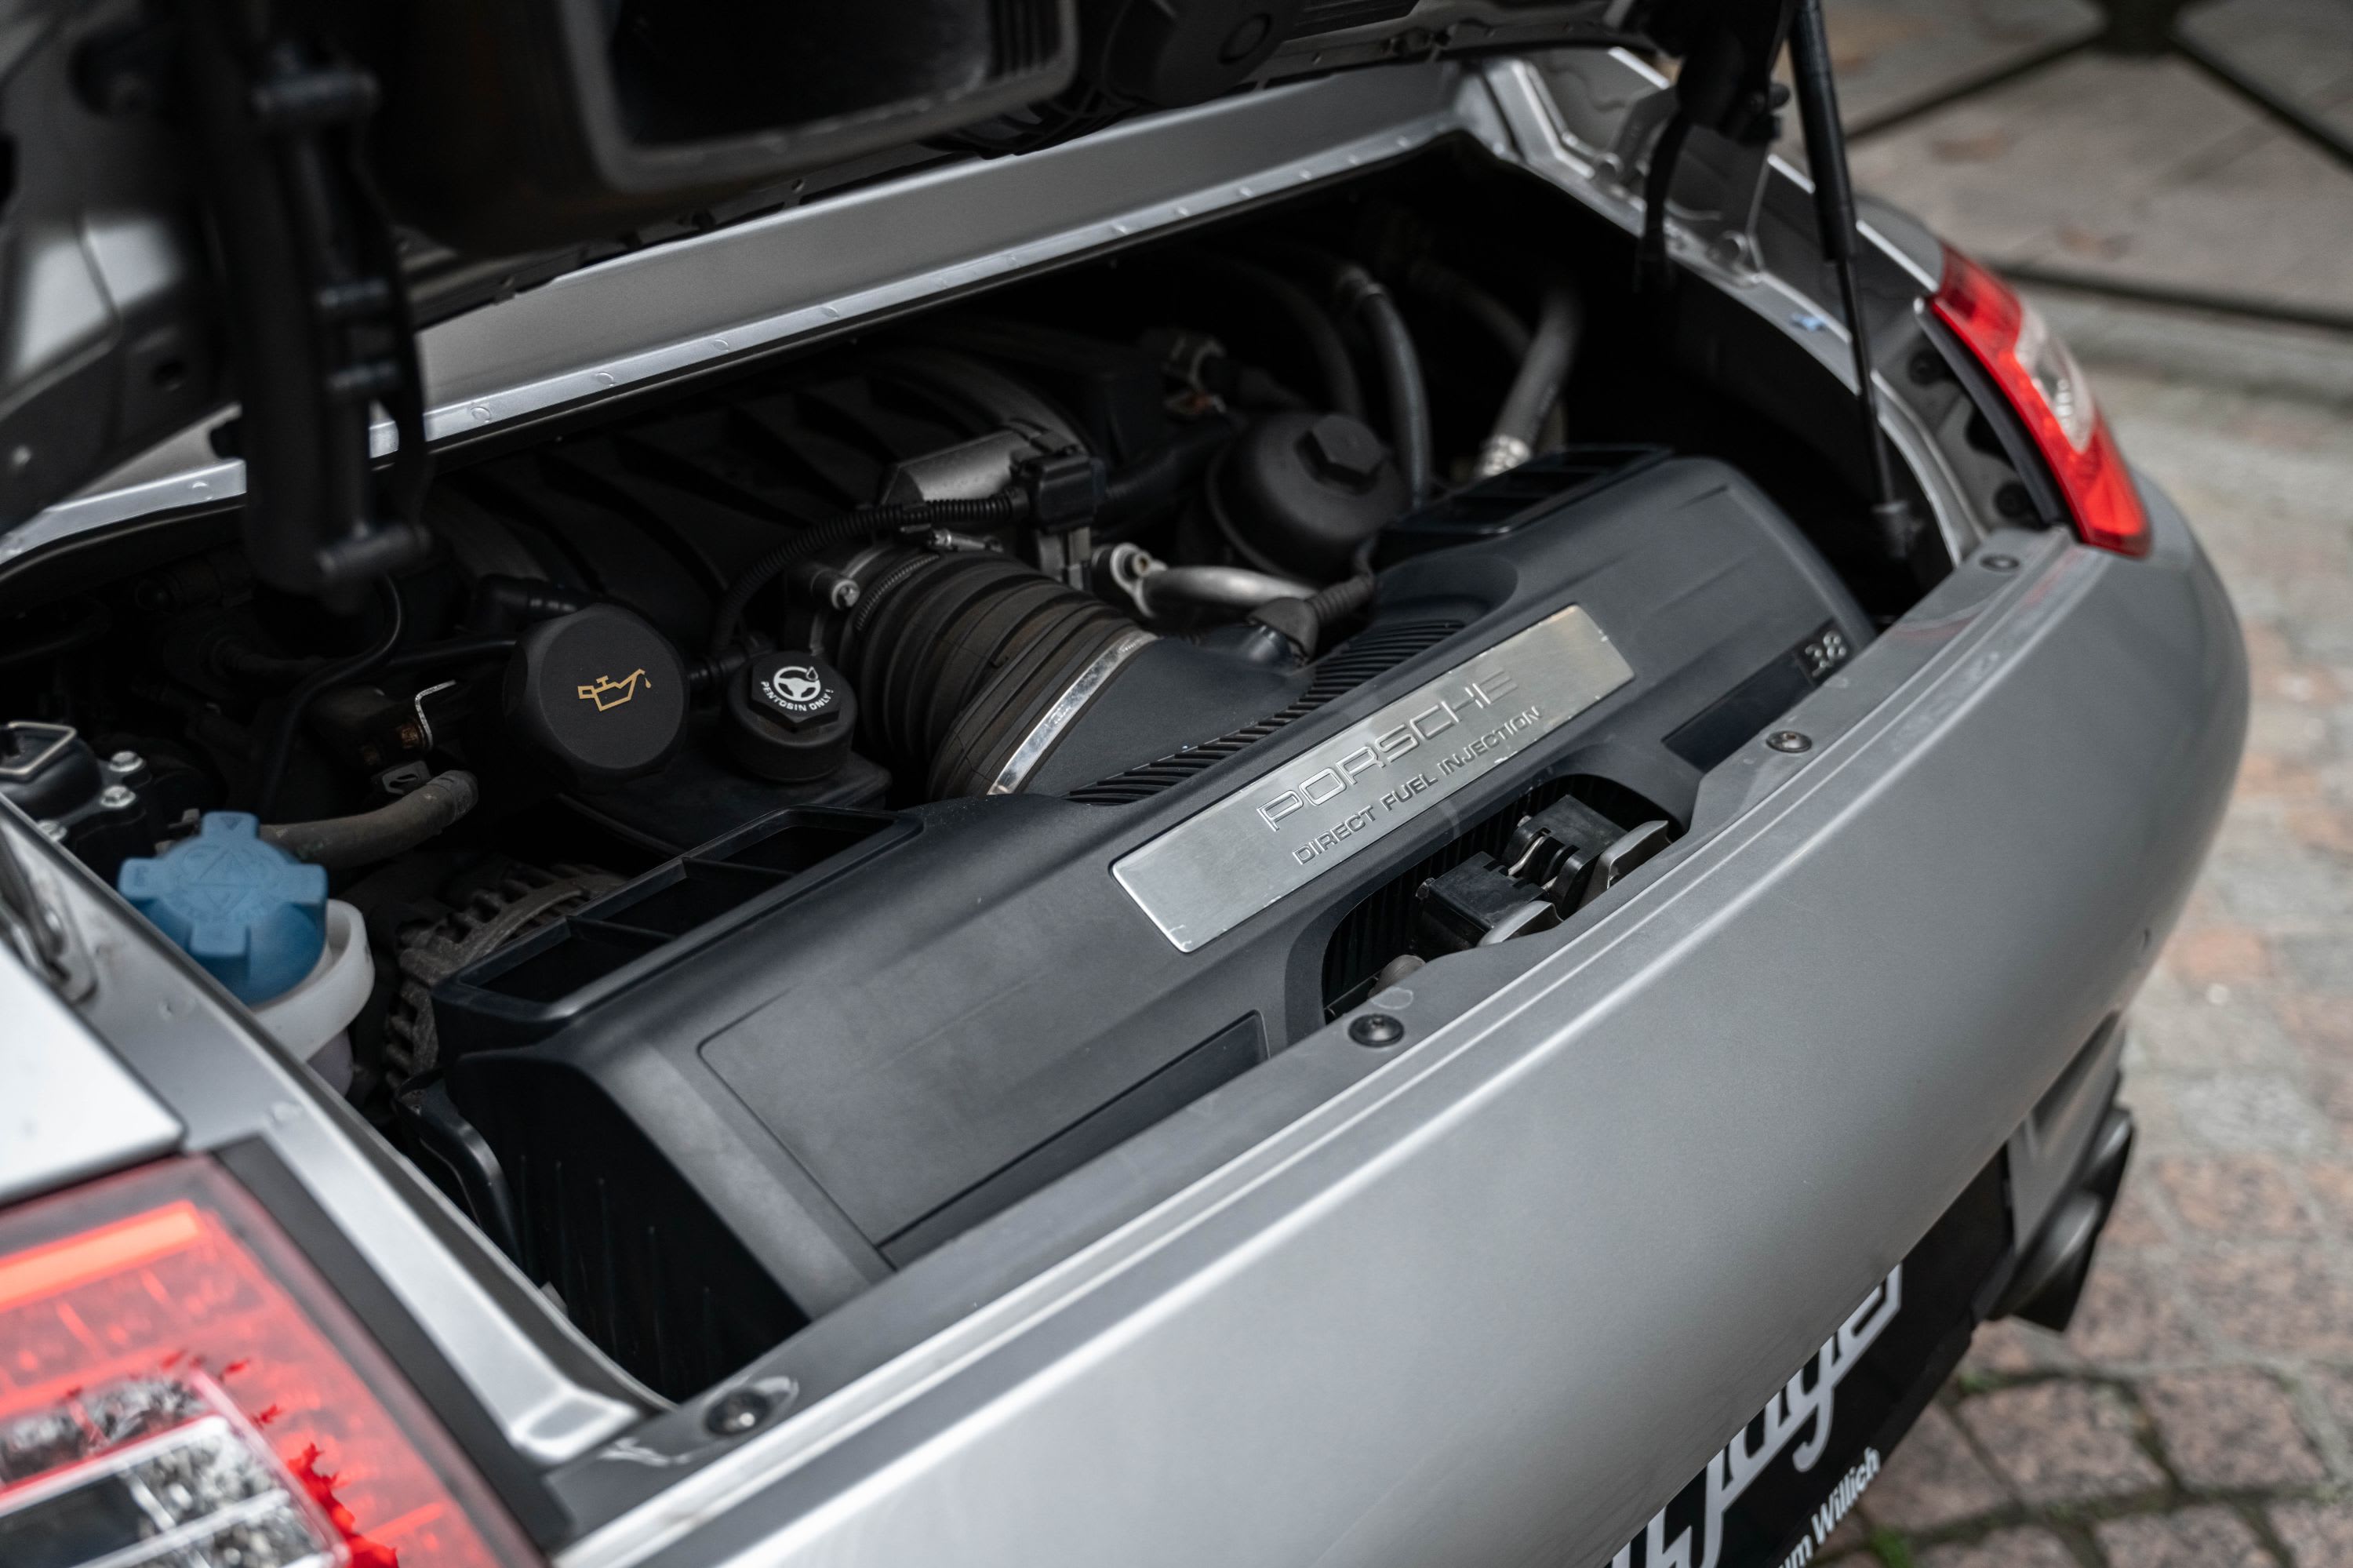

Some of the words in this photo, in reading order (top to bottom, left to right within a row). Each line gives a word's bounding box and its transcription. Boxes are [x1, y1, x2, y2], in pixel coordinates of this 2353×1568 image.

[761, 681, 807, 711] PENTOSIN
[1256, 668, 1518, 832] PORSCHE
[1292, 805, 1377, 865] DIRECT
[1380, 773, 1438, 812] FUEL
[1437, 705, 1544, 777] INJECTION
[1812, 1446, 1881, 1545] Willich
